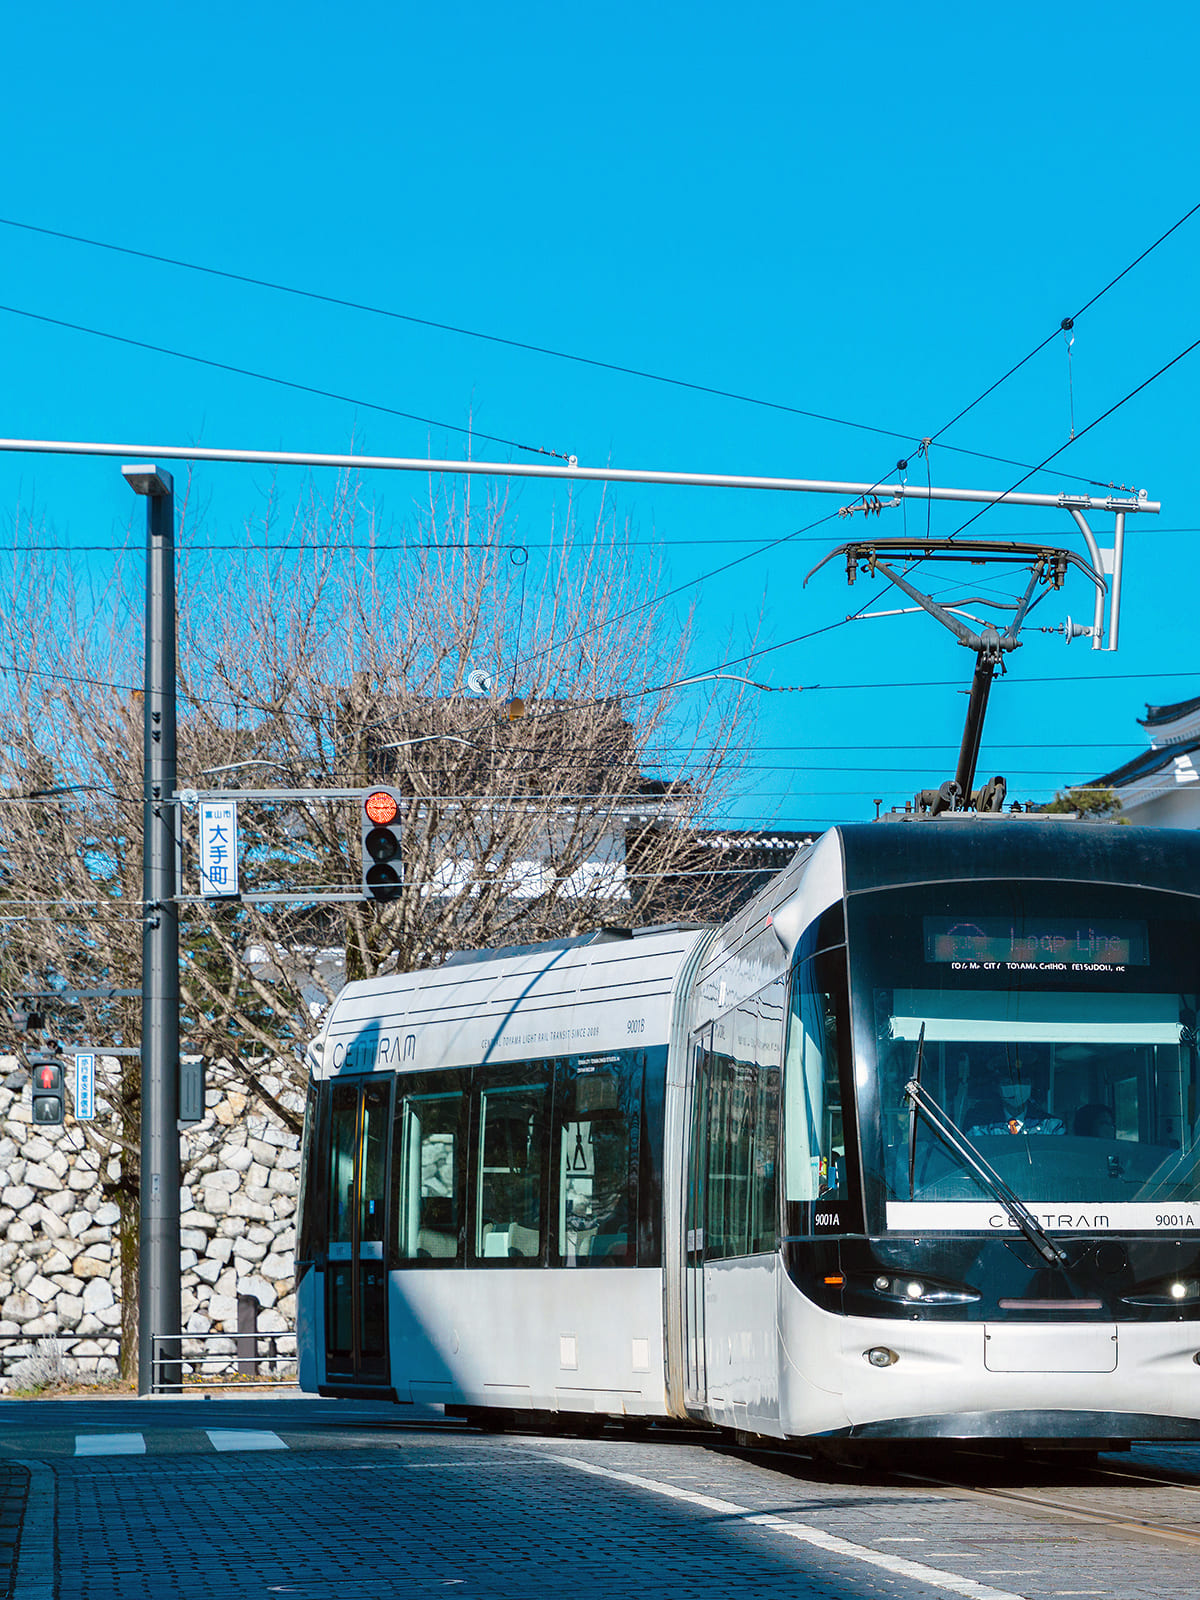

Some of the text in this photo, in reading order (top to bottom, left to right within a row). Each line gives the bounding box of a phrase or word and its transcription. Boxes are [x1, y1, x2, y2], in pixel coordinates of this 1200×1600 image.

[208, 824, 229, 885] 大手町
[1076, 928, 1122, 951] Line
[571, 1027, 586, 1039] SINCE
[626, 1018, 645, 1034] 9001B
[333, 1034, 416, 1069] CENTRAM
[815, 1213, 840, 1226] 9001A
[1155, 1214, 1195, 1227] 9001A
